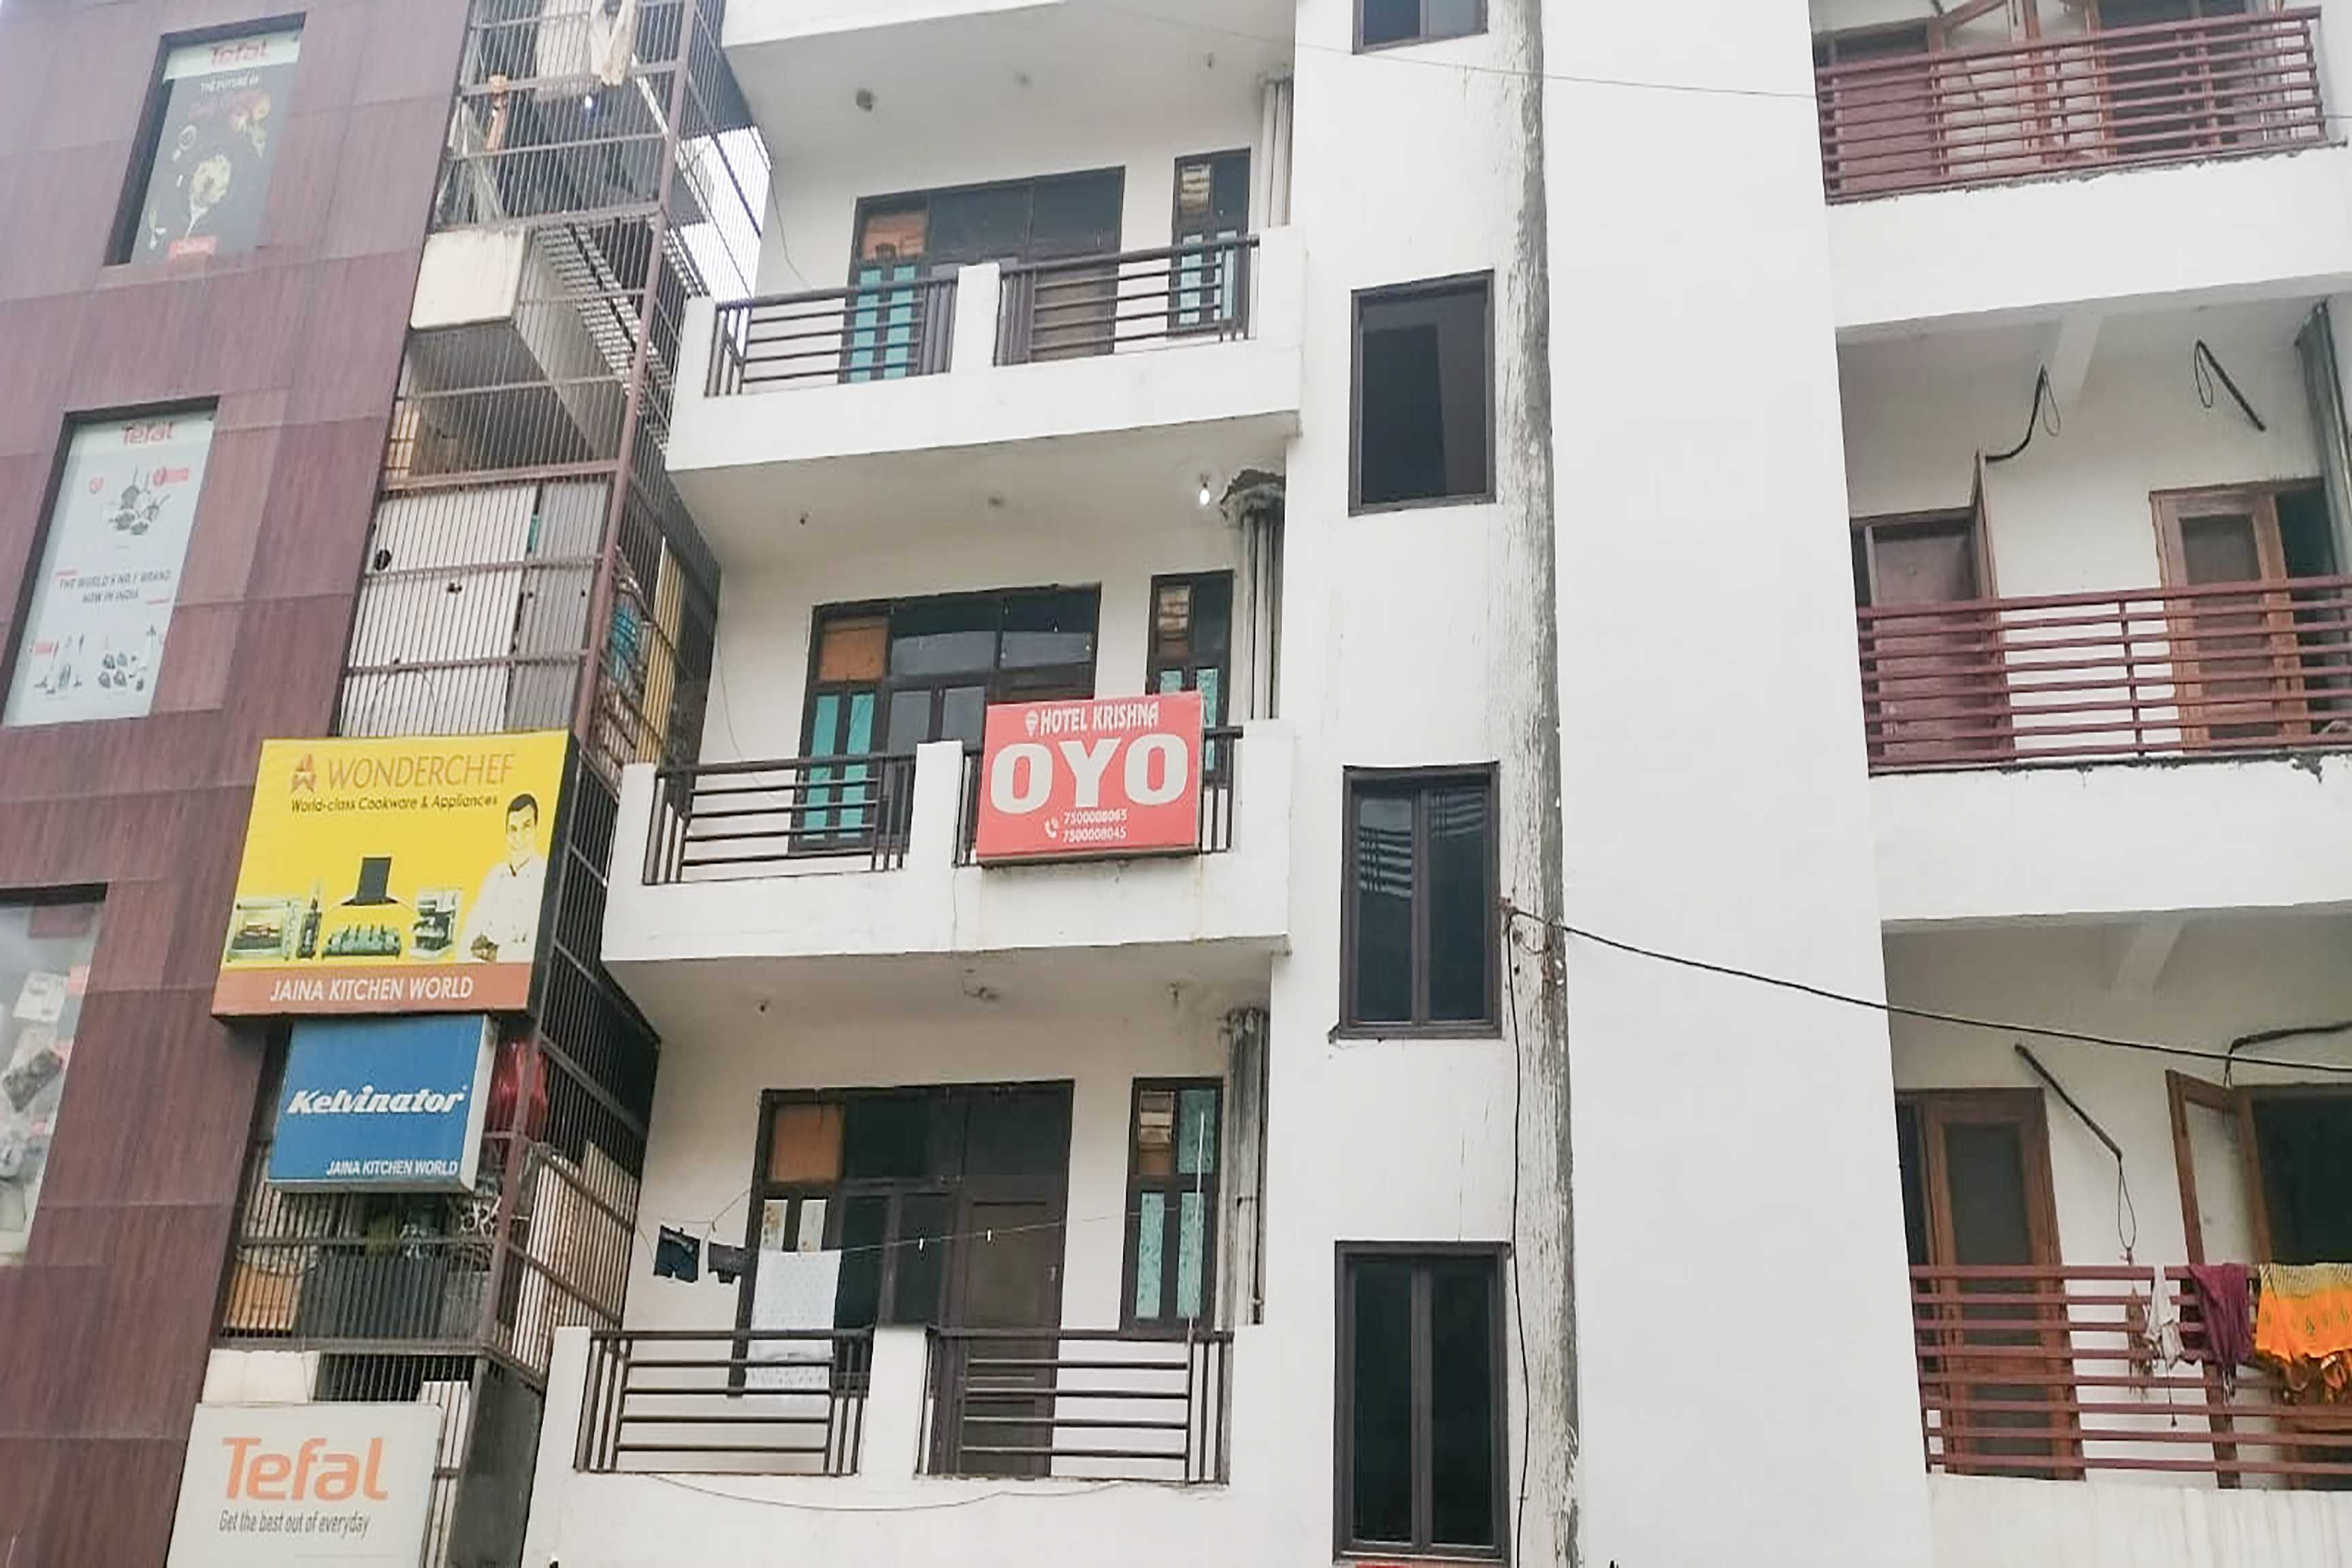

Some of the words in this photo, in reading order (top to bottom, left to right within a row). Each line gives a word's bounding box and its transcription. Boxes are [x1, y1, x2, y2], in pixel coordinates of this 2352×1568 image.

[1040, 706, 1088, 737] HOTEL
[1093, 701, 1159, 732] KRISHNA
[328, 753, 514, 790] WONDERCHEF
[990, 733, 1189, 815] OYO
[291, 796, 355, 813] World-class
[359, 795, 417, 811] Cookware
[420, 794, 429, 808] &
[431, 792, 497, 811] Appliances
[270, 980, 324, 1002] JAINA
[328, 977, 405, 1001] KITCHEN
[409, 975, 474, 1000] WORLD
[287, 1085, 466, 1114] Kelvinator
[326, 1160, 361, 1176] JAINA
[362, 1160, 412, 1175] KITCHEN
[414, 1159, 459, 1175] WORLD
[222, 1437, 389, 1501] Tefal
[218, 1509, 239, 1532] Get
[240, 1509, 257, 1532] the
[259, 1509, 284, 1532] best
[285, 1512, 304, 1533] out
[306, 1510, 318, 1532] of
[318, 1510, 371, 1540] everyday
